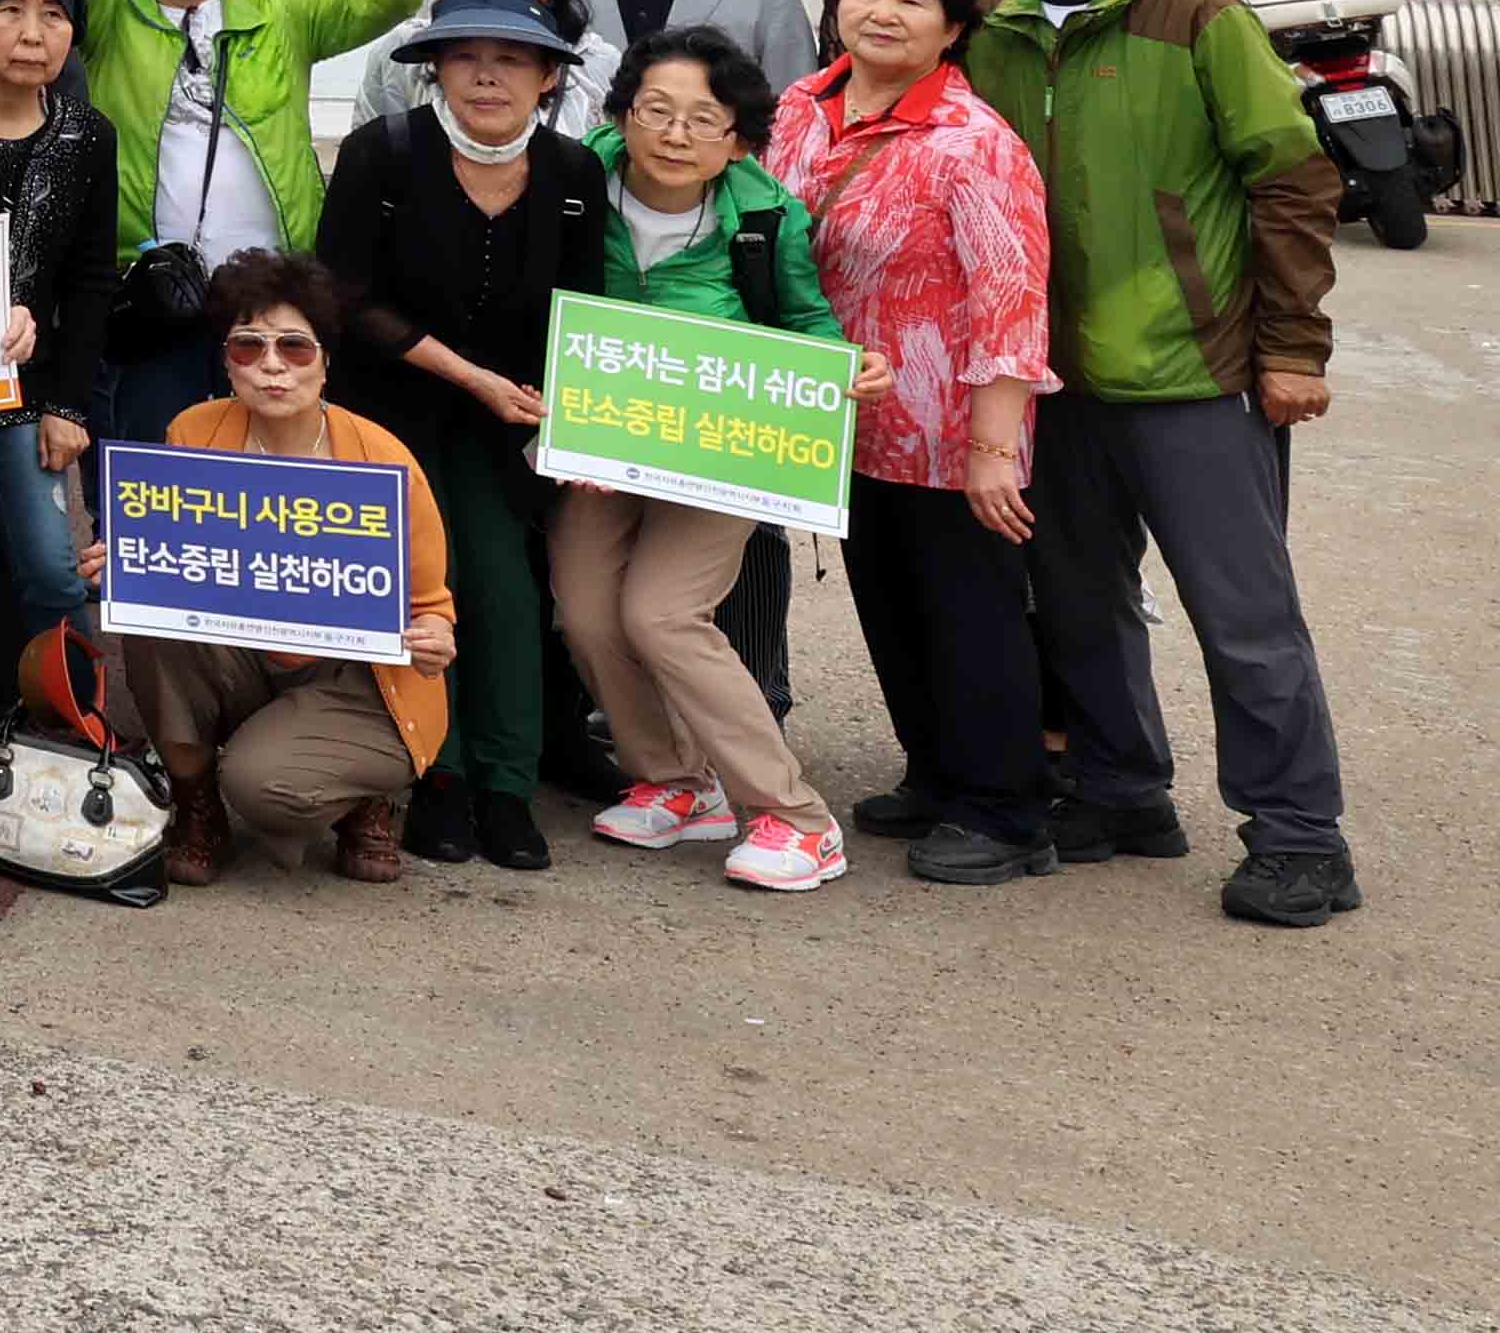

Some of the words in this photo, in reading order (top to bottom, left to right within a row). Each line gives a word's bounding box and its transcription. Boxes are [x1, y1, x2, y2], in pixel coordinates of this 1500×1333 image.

[565, 332, 688, 385] 자동차는
[695, 353, 756, 399] 잠시
[764, 368, 840, 412] 쉬GO
[561, 387, 686, 444] 탄소중립
[694, 411, 835, 468] 실천하GO
[117, 481, 247, 529] 장바구니
[255, 495, 391, 537] 사용으로
[118, 537, 239, 586] 탄소중립
[248, 553, 391, 598] 실천하GO
